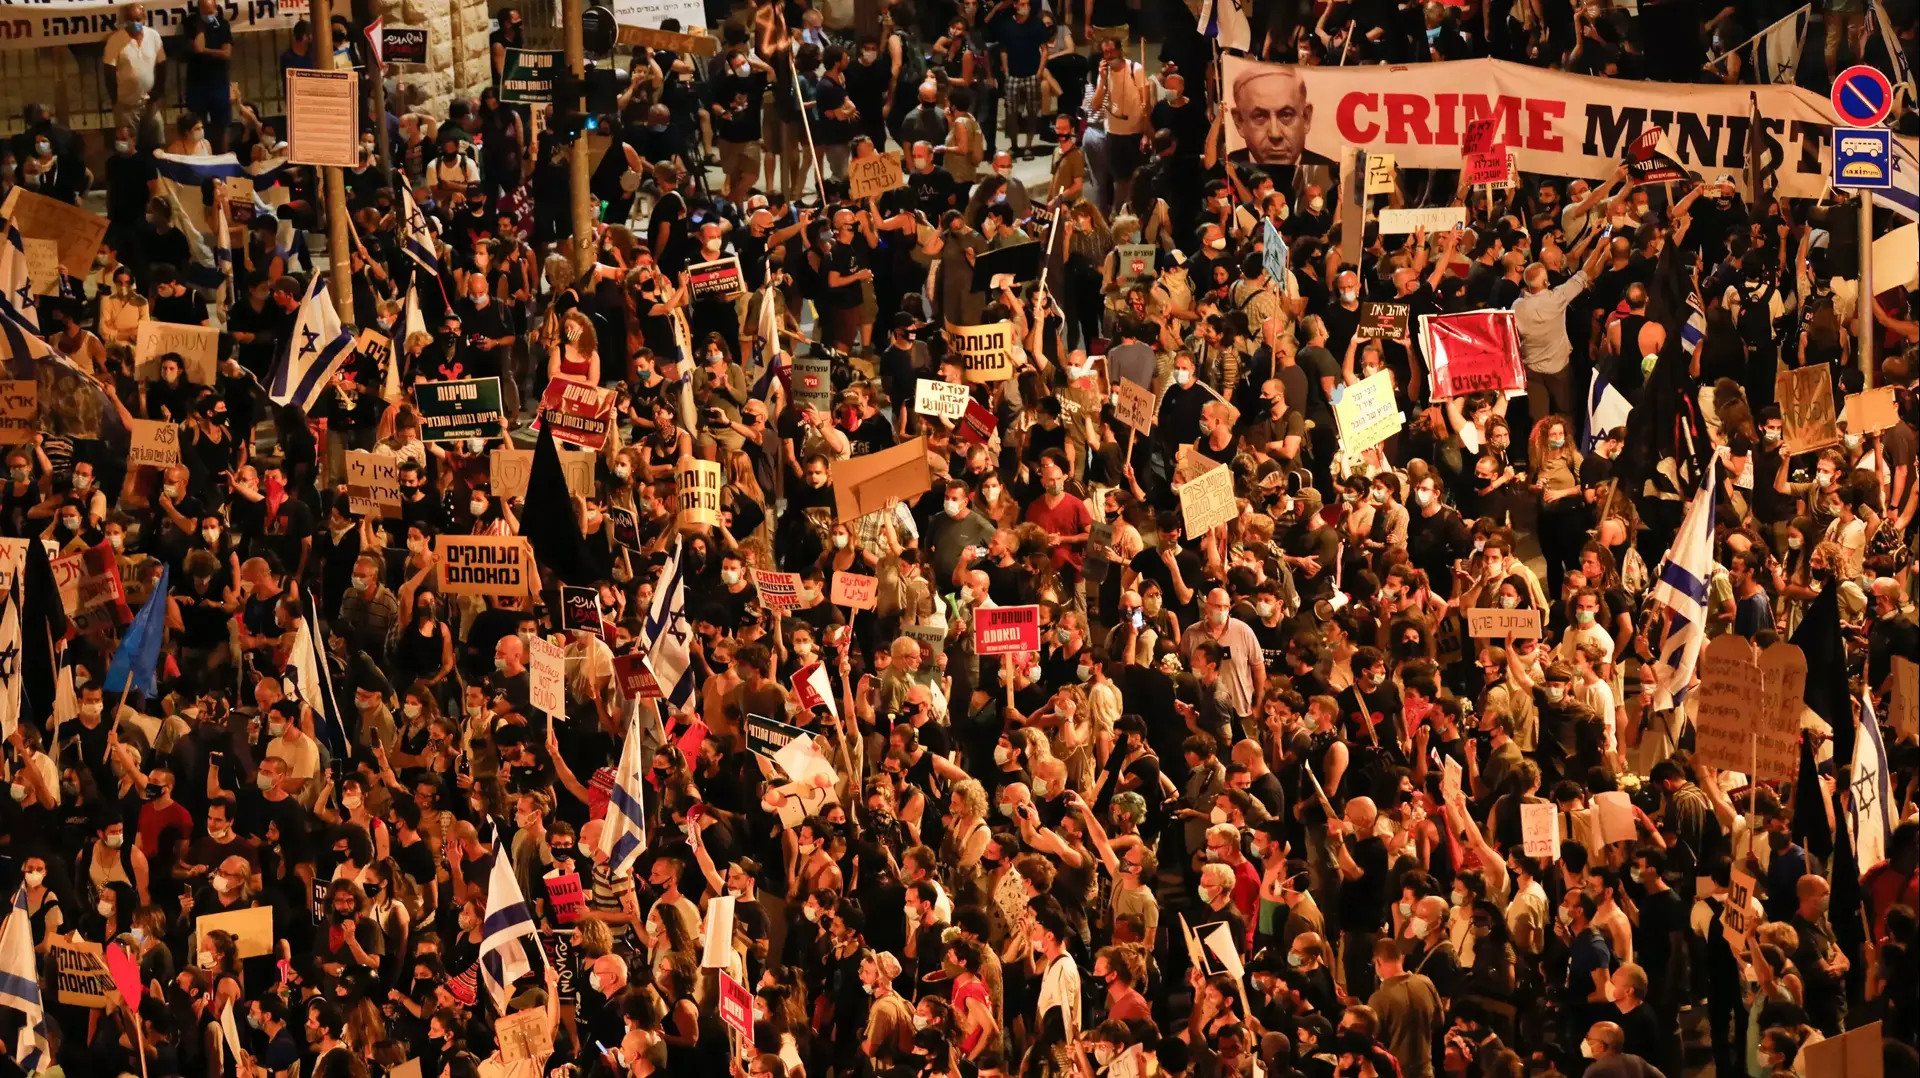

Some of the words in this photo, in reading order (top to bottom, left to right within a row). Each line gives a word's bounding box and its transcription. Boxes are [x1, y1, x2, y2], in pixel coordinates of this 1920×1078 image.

[43, 14, 118, 37] אותה!
[519, 54, 553, 68] שחיתות
[1336, 91, 1566, 153] CRIME
[804, 377, 817, 387] נגיף
[931, 382, 944, 392] לא
[437, 384, 478, 402] שחיתות
[564, 384, 596, 406] שחיתות
[947, 385, 965, 395] עוד
[427, 415, 451, 428] החברת
[451, 413, 476, 428] בבטחון
[562, 414, 584, 430] בבטחון
[155, 425, 175, 444] לא
[352, 460, 365, 476] לי
[373, 464, 394, 480] אין
[370, 485, 399, 500] ארץ
[350, 496, 380, 508] אחרת
[447, 545, 519, 566] מנותקים
[756, 571, 794, 584] CRIME
[758, 581, 795, 592] MINISTER
[762, 593, 799, 605] CRIME
[989, 610, 1033, 627] מושחתים,
[1499, 616, 1533, 628] אנחנו
[981, 627, 1021, 644] נמאסתם.
[539, 674, 552, 689] NOT
[534, 686, 557, 710] FOUND
